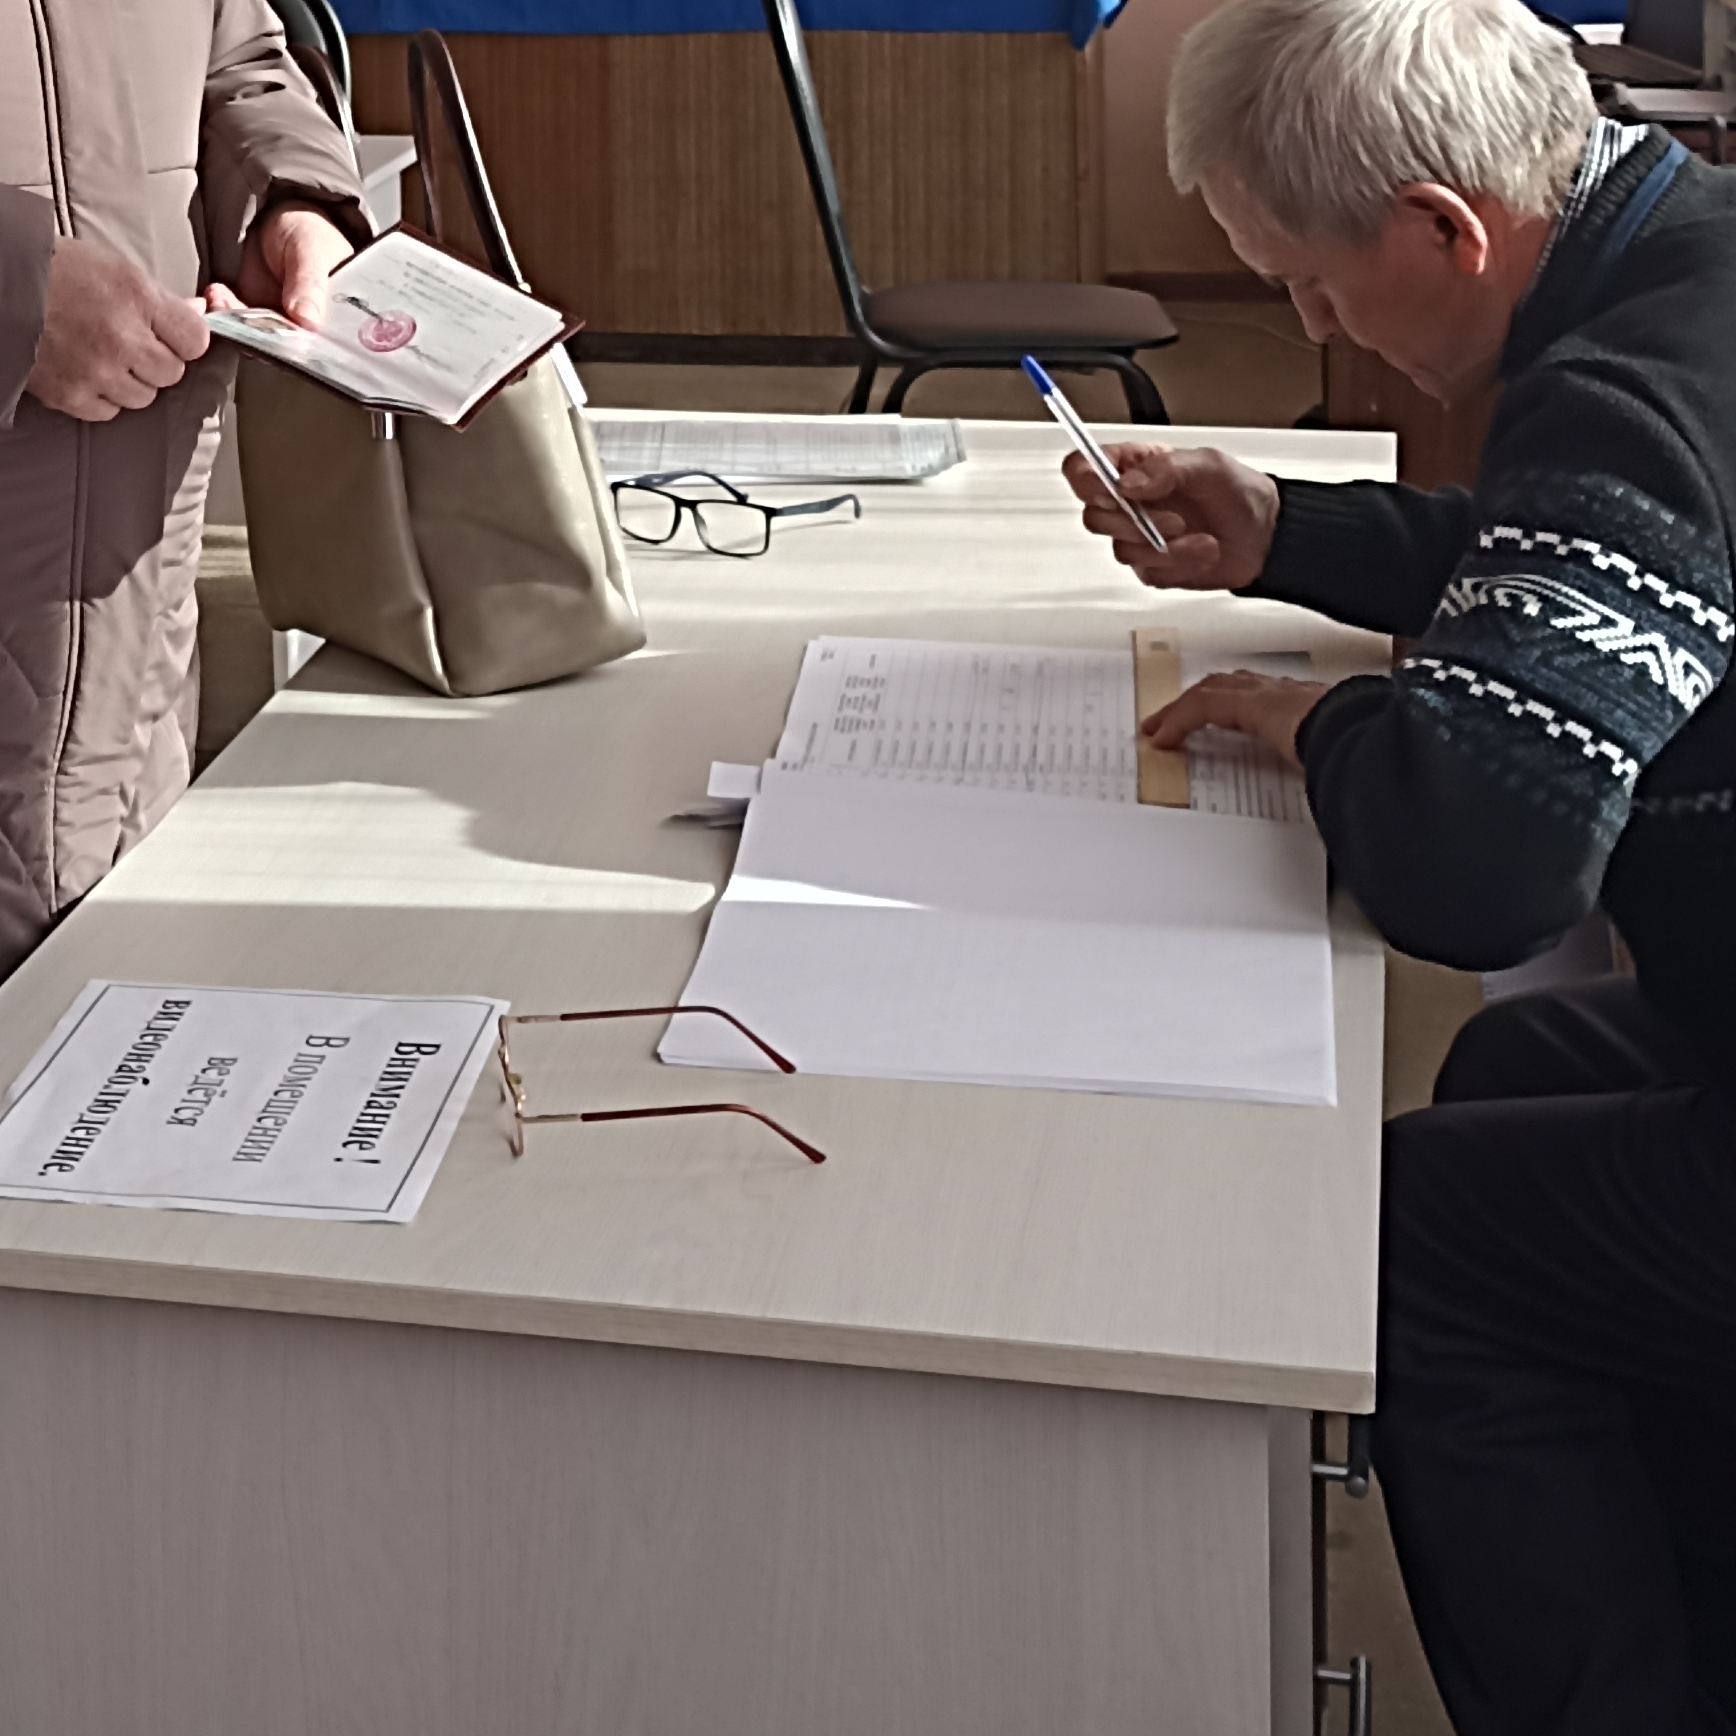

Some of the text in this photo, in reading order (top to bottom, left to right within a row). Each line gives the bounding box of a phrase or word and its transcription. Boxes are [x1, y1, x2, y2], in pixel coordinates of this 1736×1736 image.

[37, 999, 193, 1176] видеонаблюдение.
[166, 1057, 238, 1127] ведётся
[232, 1034, 351, 1163] В помещении
